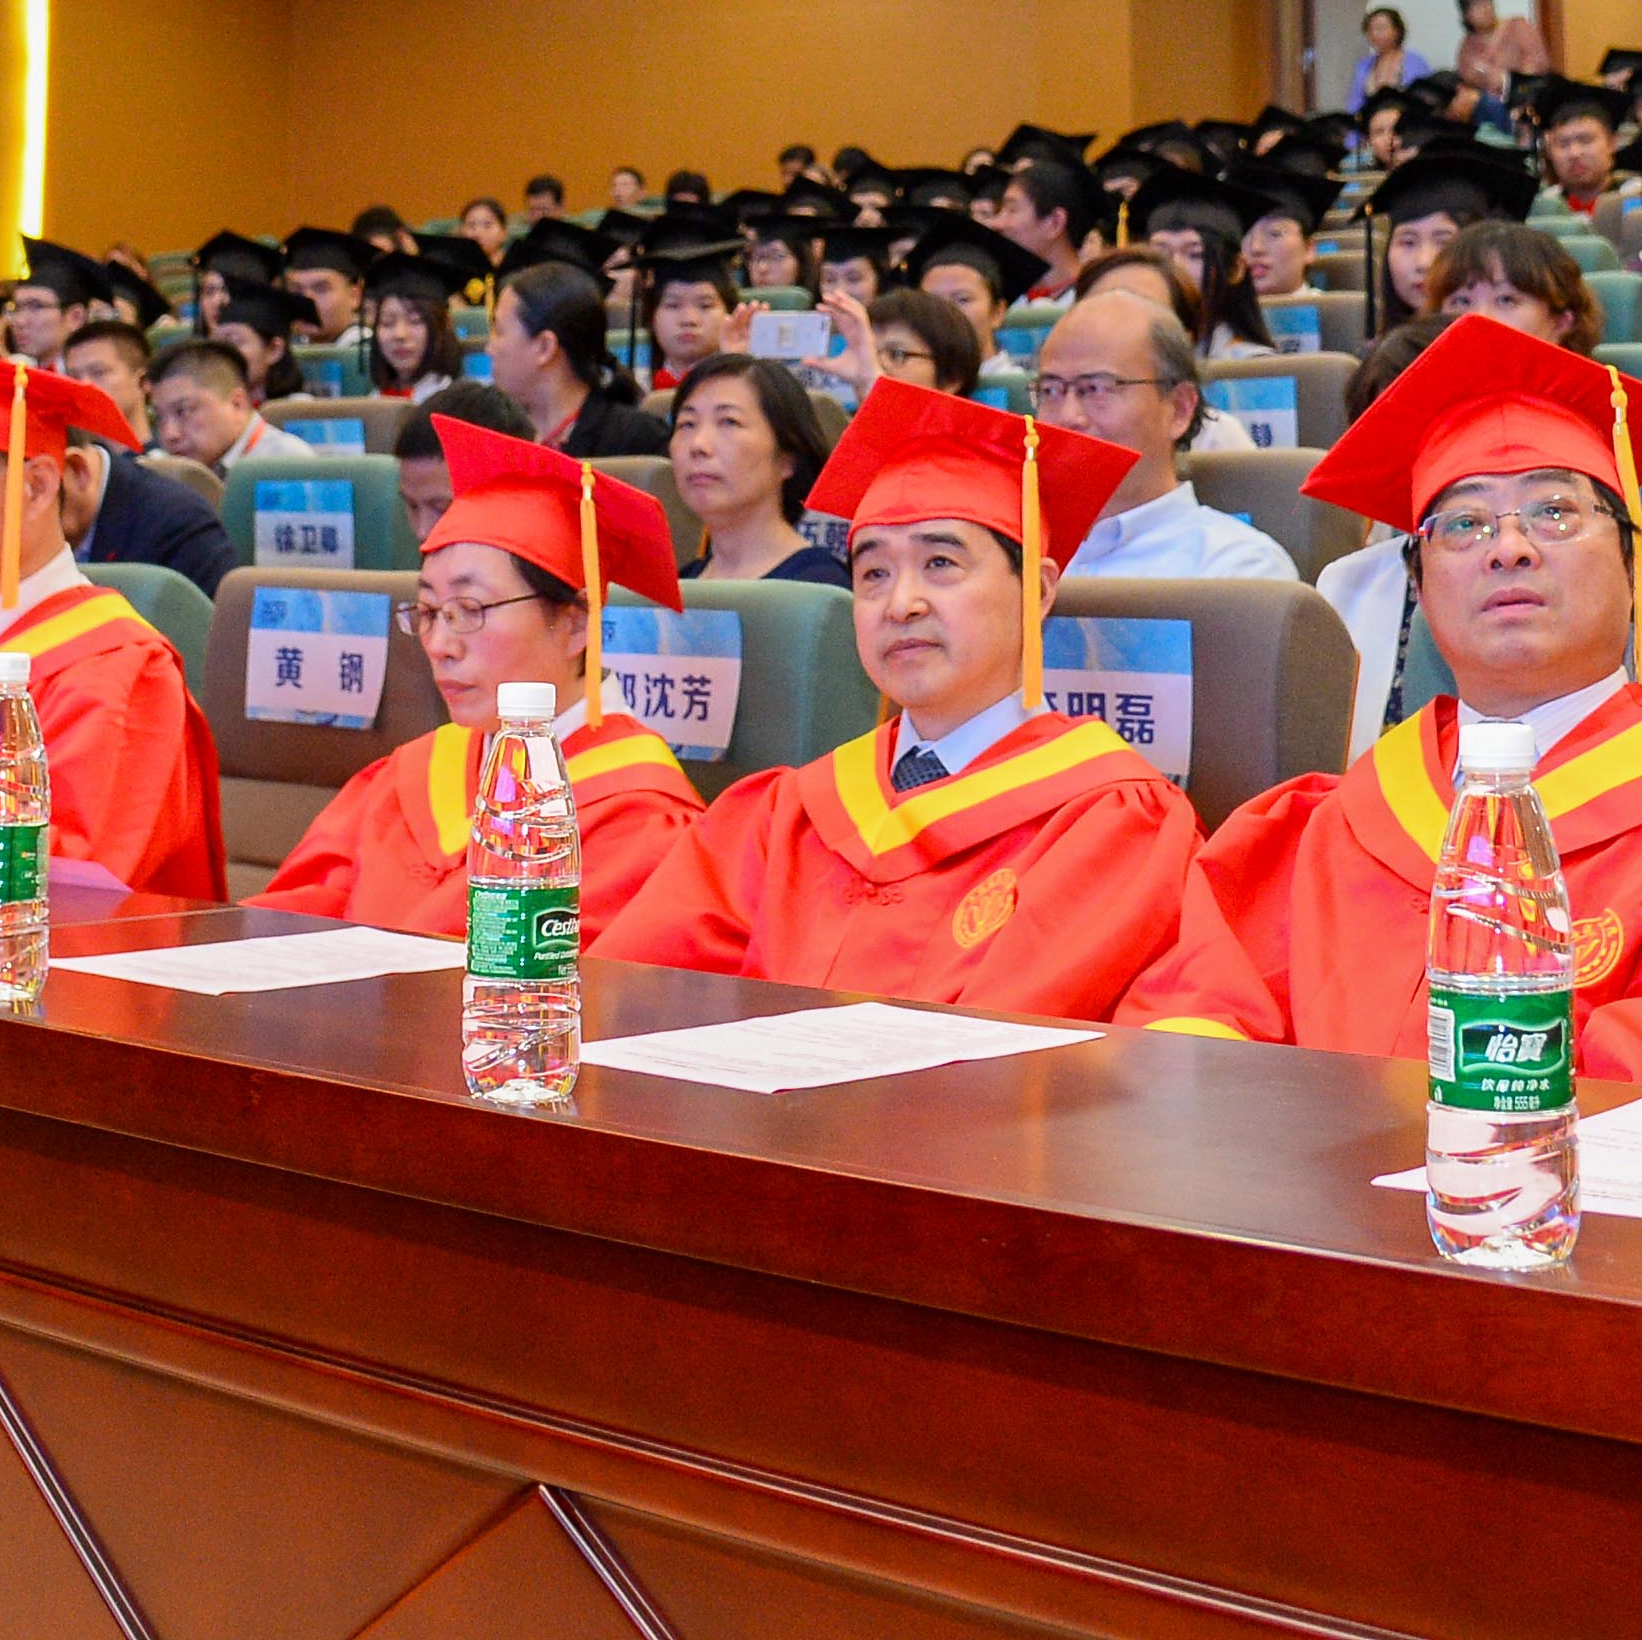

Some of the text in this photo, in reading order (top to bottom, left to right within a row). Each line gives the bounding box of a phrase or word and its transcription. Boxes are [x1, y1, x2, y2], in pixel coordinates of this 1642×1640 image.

[1480, 1077, 1551, 1093] 饮用纯净水
